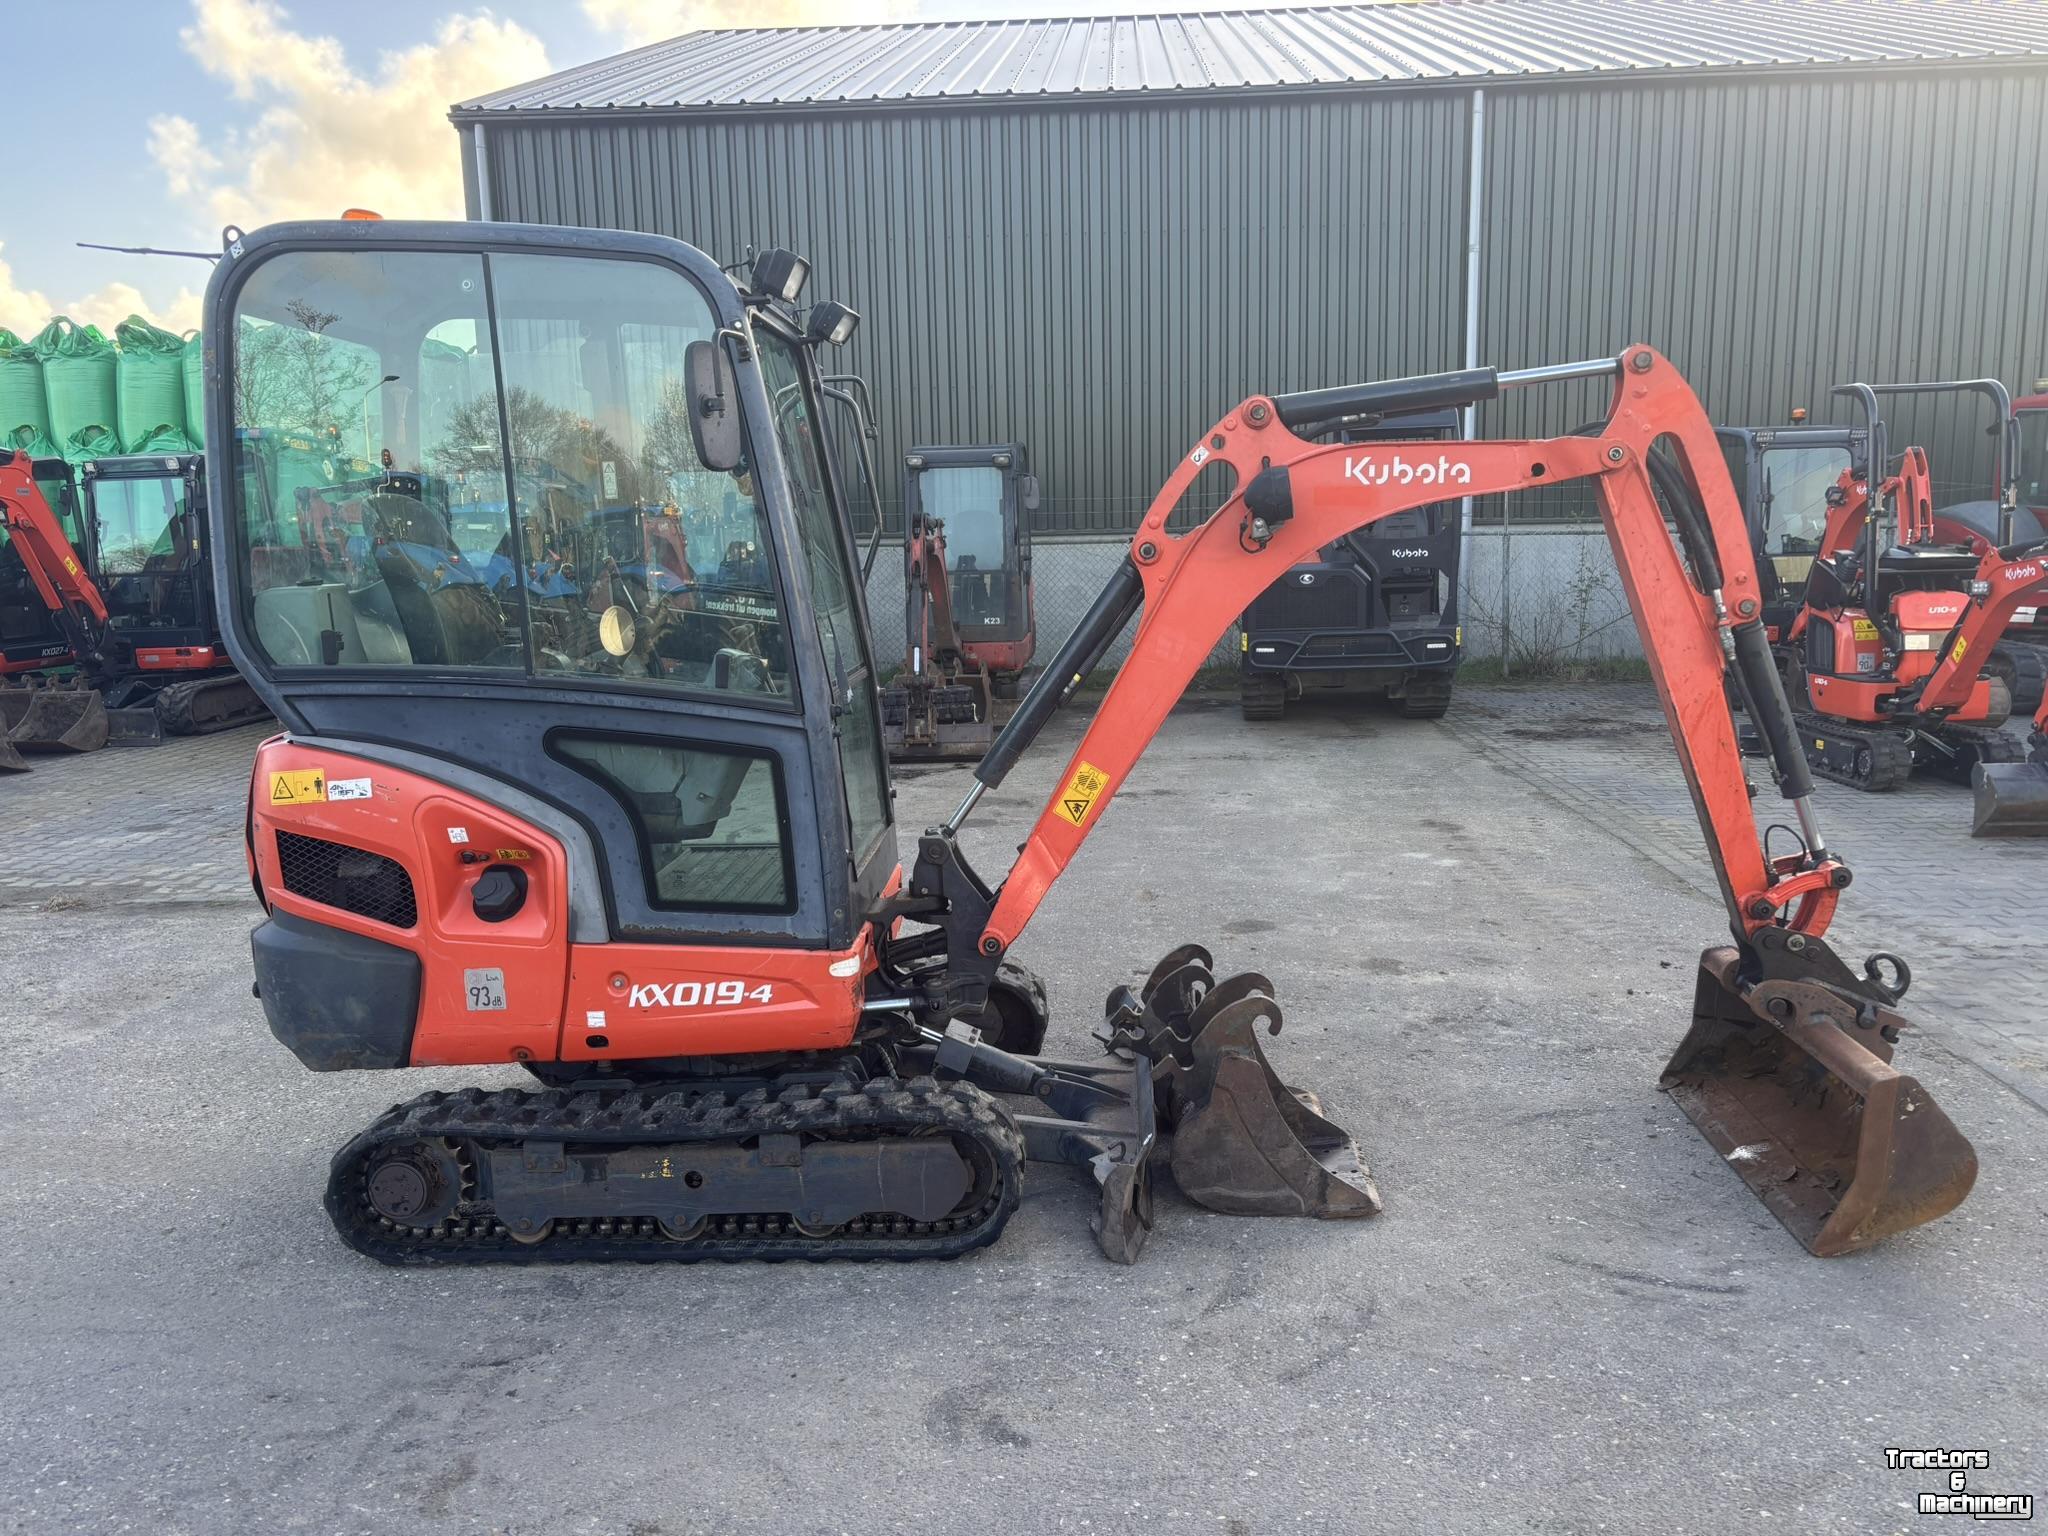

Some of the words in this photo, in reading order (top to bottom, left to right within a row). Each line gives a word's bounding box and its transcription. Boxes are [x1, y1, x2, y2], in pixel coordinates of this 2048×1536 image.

[1345, 456, 1471, 485] Kubota
[1392, 548, 1429, 558] Kubota
[2006, 565, 2036, 580] Kubota
[984, 617, 1000, 625] K23
[470, 986, 490, 1007] 93
[492, 996, 502, 1007] dB
[629, 981, 773, 1008] KX019-4
